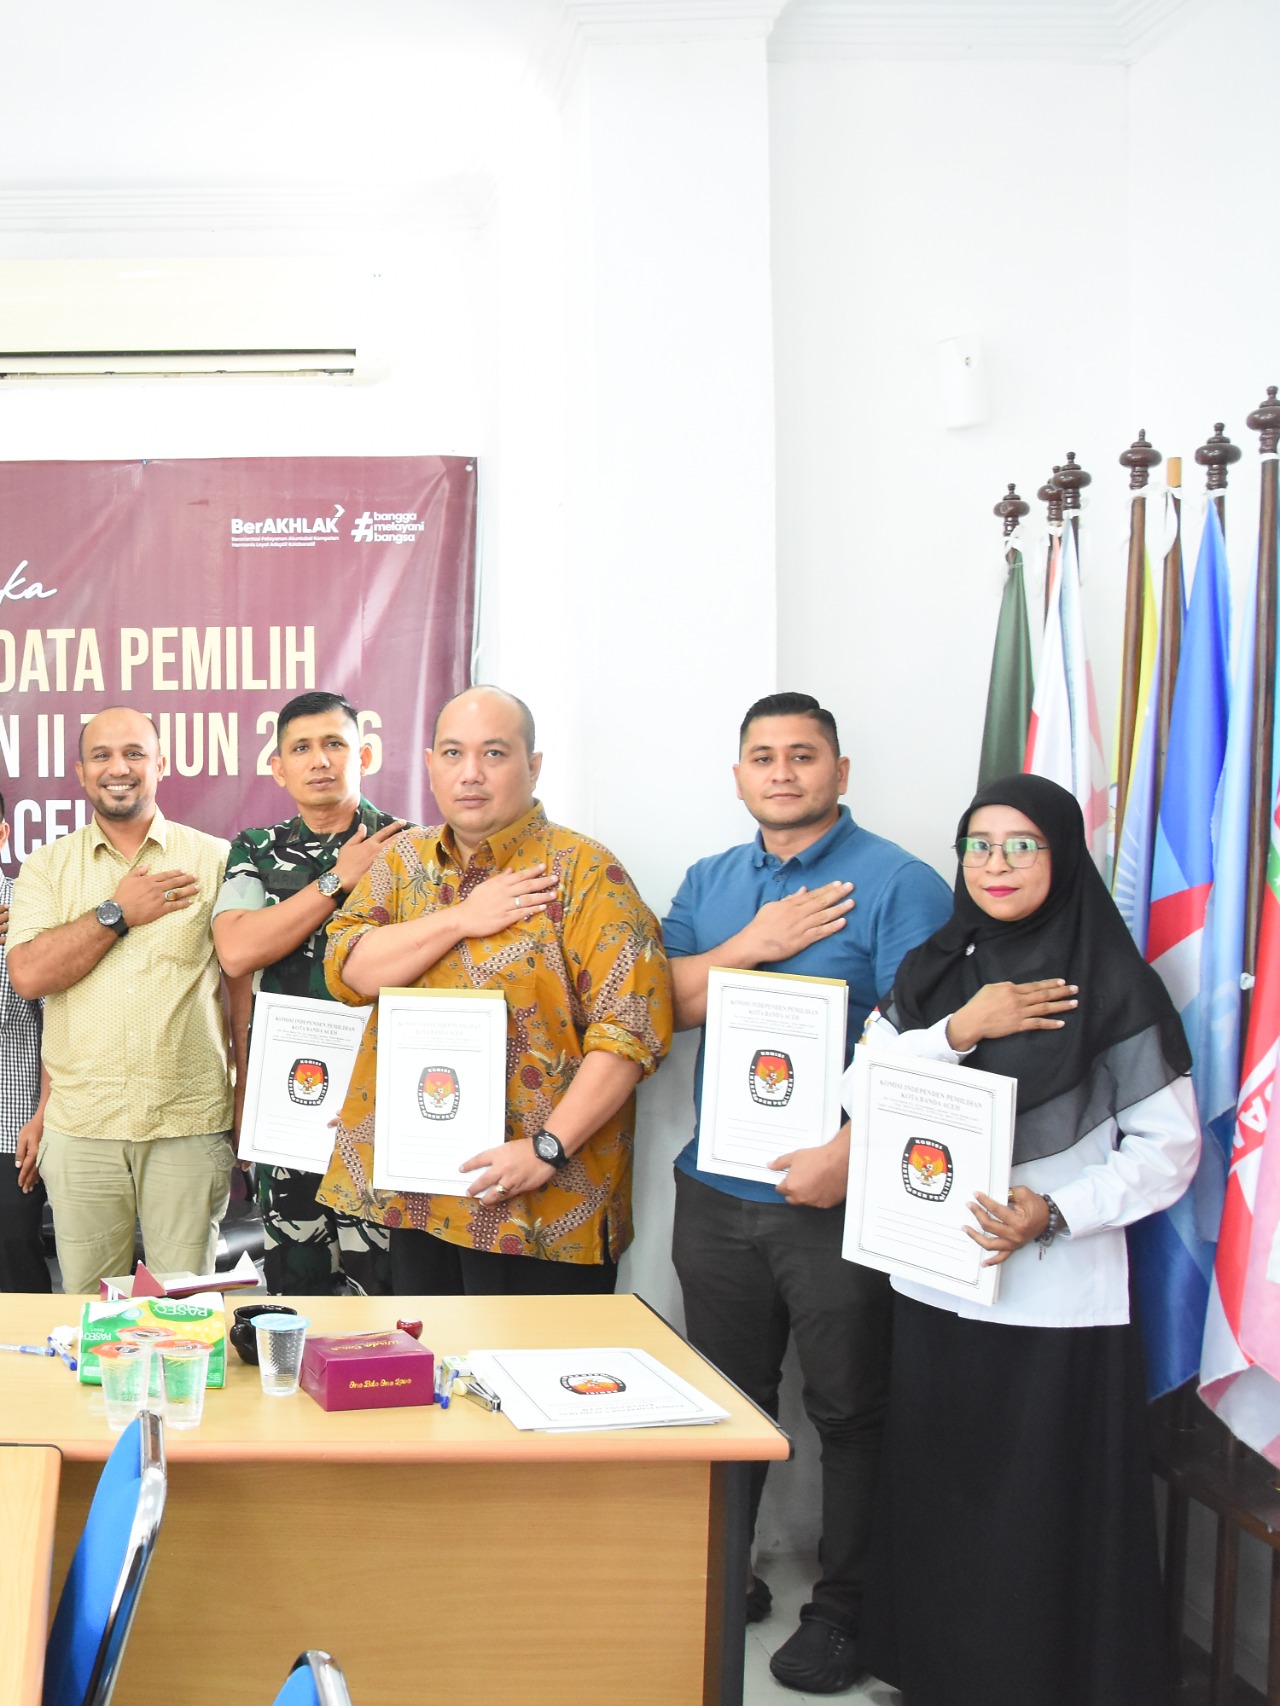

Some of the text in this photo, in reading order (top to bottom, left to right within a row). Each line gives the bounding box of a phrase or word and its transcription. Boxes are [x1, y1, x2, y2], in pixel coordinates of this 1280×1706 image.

[374, 512, 417, 524] bangga
[231, 518, 339, 534] BerAKHLAK
[374, 521, 424, 534] melayani
[374, 532, 416, 544] bangsa
[122, 625, 316, 692] PEMILIH
[37, 714, 65, 778] II
[80, 712, 239, 776] HUN
[256, 710, 383, 776] 26
[904, 1083, 945, 1099] INDEPENDEN
[84, 1332, 112, 1340] PASEO
